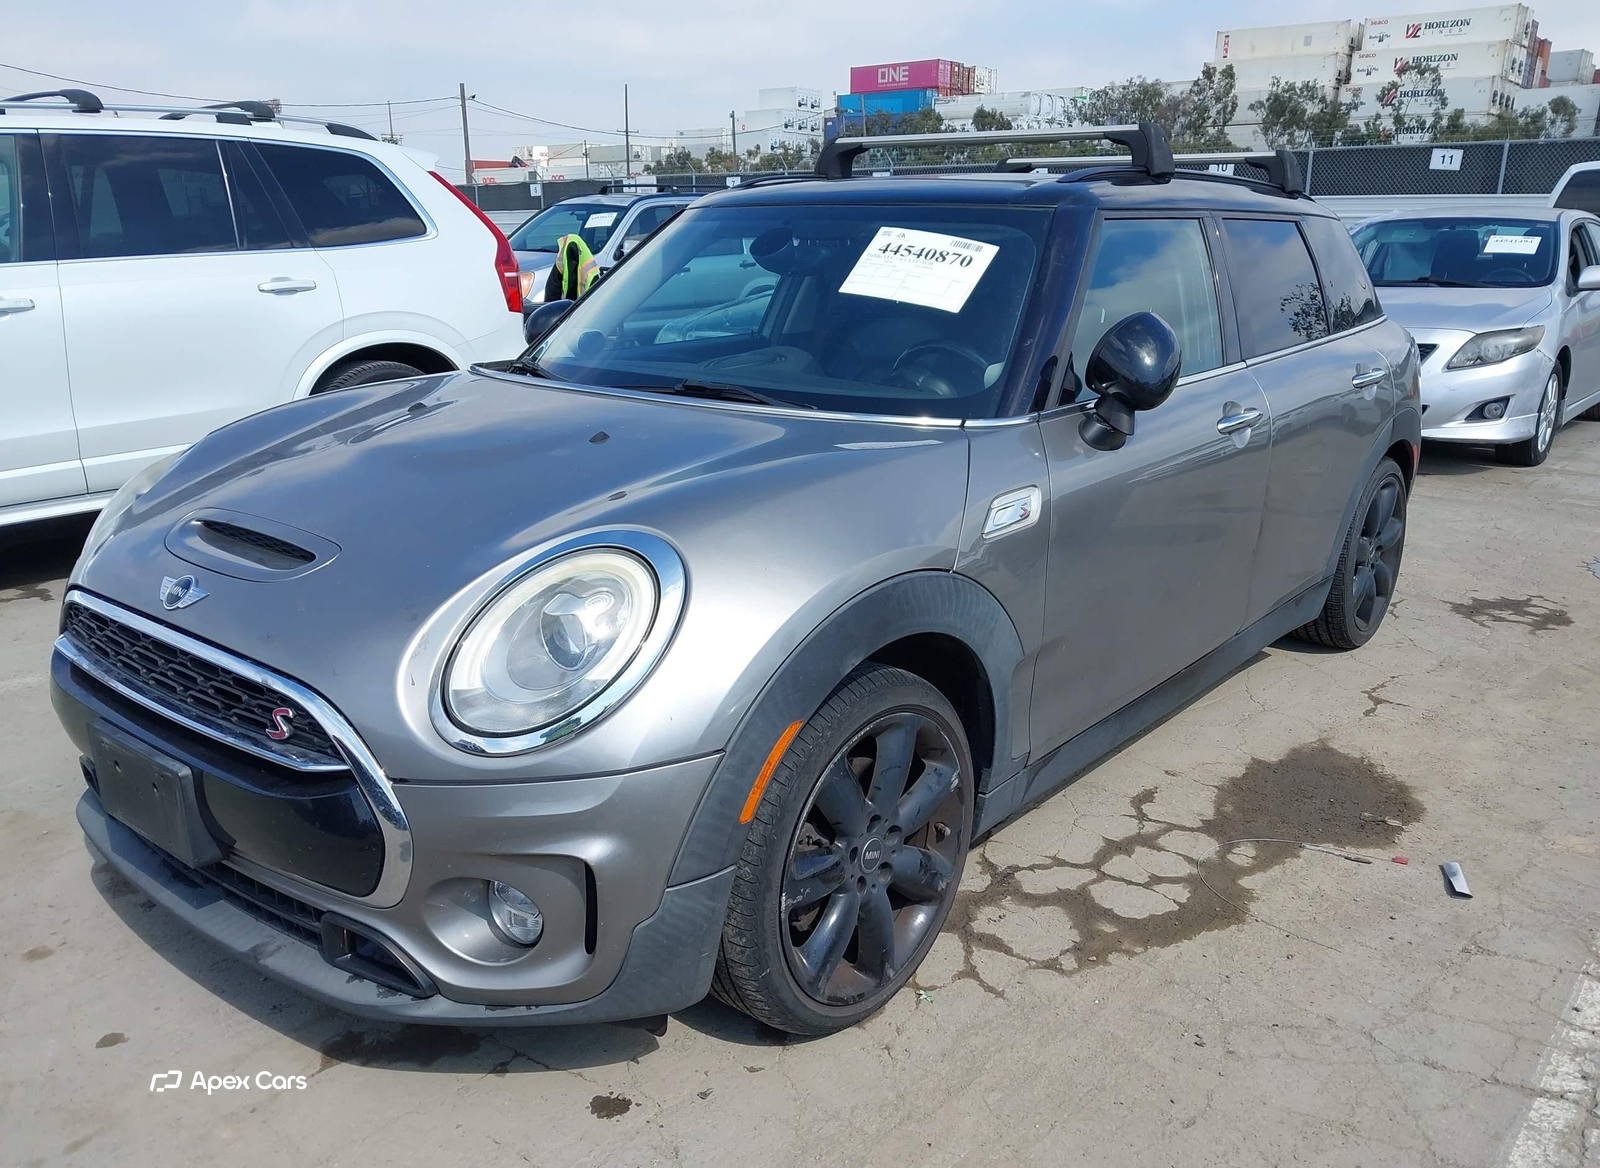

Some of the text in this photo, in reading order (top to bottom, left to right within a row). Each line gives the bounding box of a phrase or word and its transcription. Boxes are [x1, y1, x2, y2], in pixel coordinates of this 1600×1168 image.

[1424, 18, 1472, 30] HORIZON
[1411, 53, 1459, 64] HORIZON
[877, 66, 909, 83] ONE
[1440, 154, 1454, 165] 11
[878, 242, 974, 268] 44540870
[170, 584, 188, 597] MINI
[265, 708, 294, 740] S
[864, 850, 881, 860] MINI
